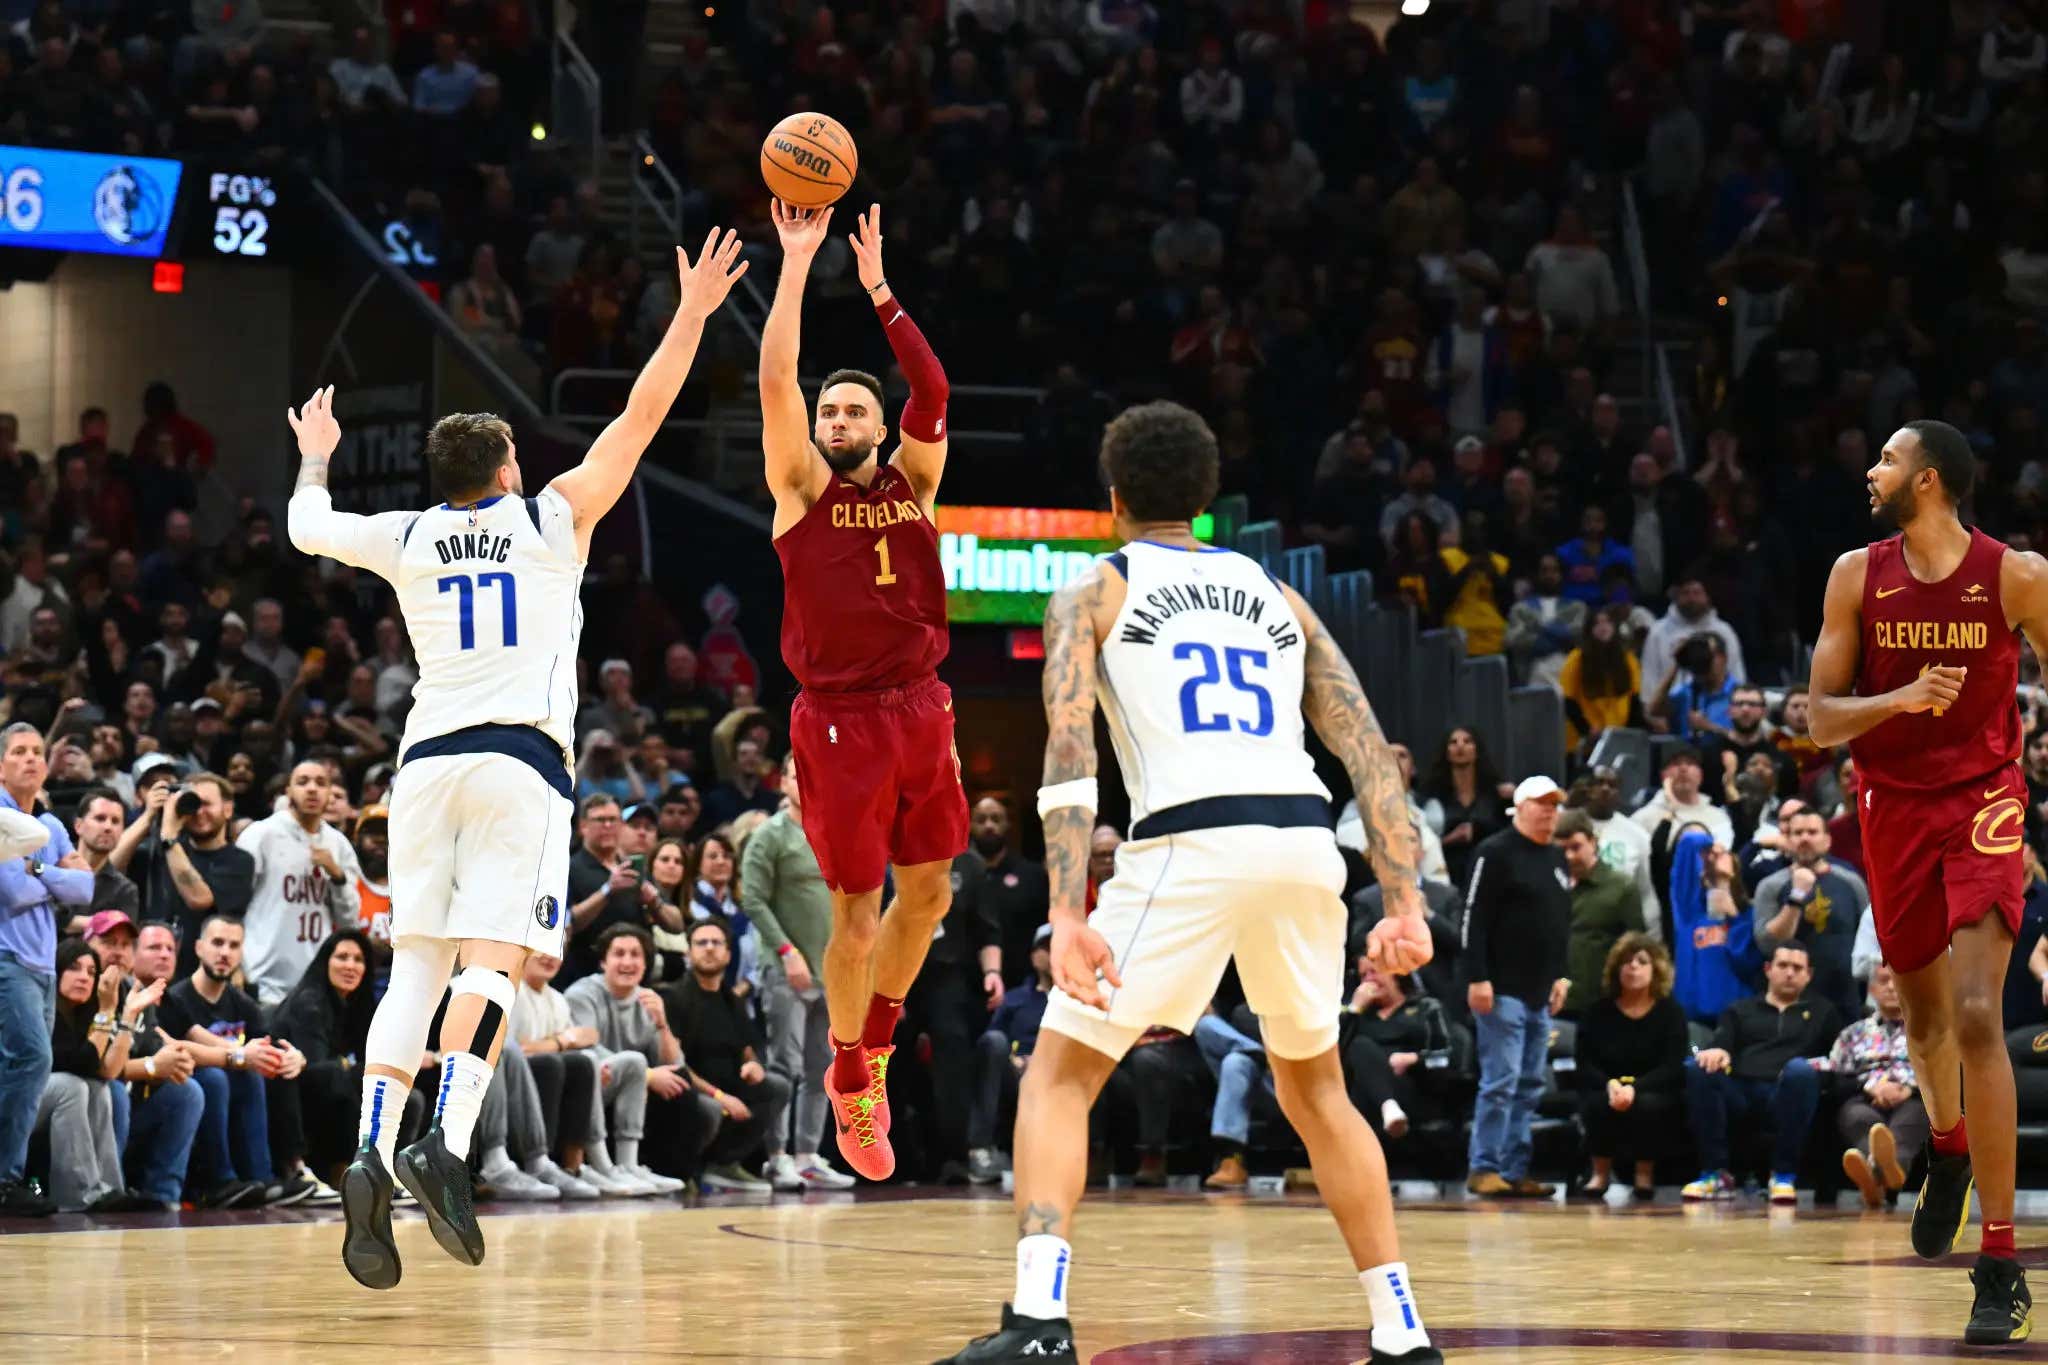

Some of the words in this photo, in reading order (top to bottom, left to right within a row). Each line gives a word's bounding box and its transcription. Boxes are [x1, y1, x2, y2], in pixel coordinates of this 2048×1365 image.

[774, 138, 832, 177] Wilson
[0, 166, 44, 232] 6
[210, 173, 276, 207] FG%
[213, 206, 269, 256] 52
[434, 528, 513, 565] DONČIĆ
[874, 533, 897, 586] 1
[940, 532, 1110, 593] Huntin
[437, 571, 518, 650] 77
[1120, 583, 1265, 645] WASHINGTON
[1961, 595, 1989, 603] CLIFFS
[1875, 621, 1988, 649] CLEVELAND
[1173, 641, 1275, 738] 25
[296, 911, 322, 943] 10
